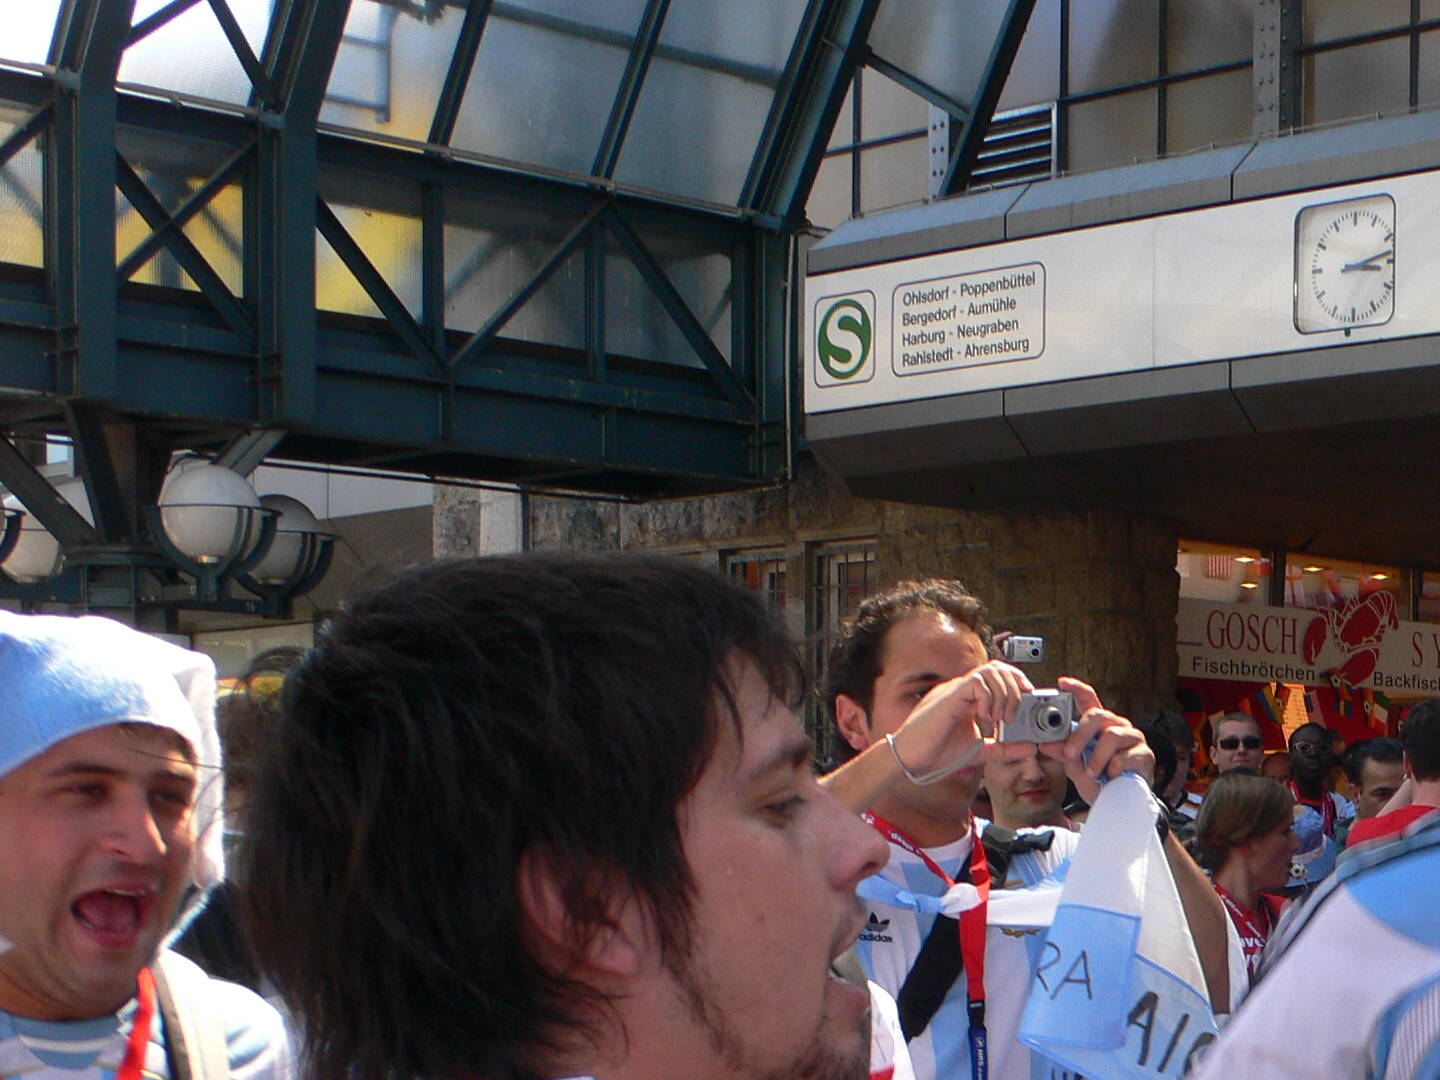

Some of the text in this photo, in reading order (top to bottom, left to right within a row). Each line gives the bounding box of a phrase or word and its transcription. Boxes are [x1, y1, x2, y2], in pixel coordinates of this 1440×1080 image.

[902, 286, 950, 306] Ohlsdorf
[960, 272, 1036, 299] Poppenbüttel
[902, 305, 957, 327] Bergedorf
[967, 298, 1017, 317] Aumühle
[902, 328, 945, 347] Harburg
[957, 318, 1019, 339] Neugraben
[902, 348, 954, 368] Rahlstedt
[964, 337, 1030, 359] Ahrensburg
[1206, 608, 1297, 655] GOSCH
[1193, 656, 1315, 680] Fischbrötchen
